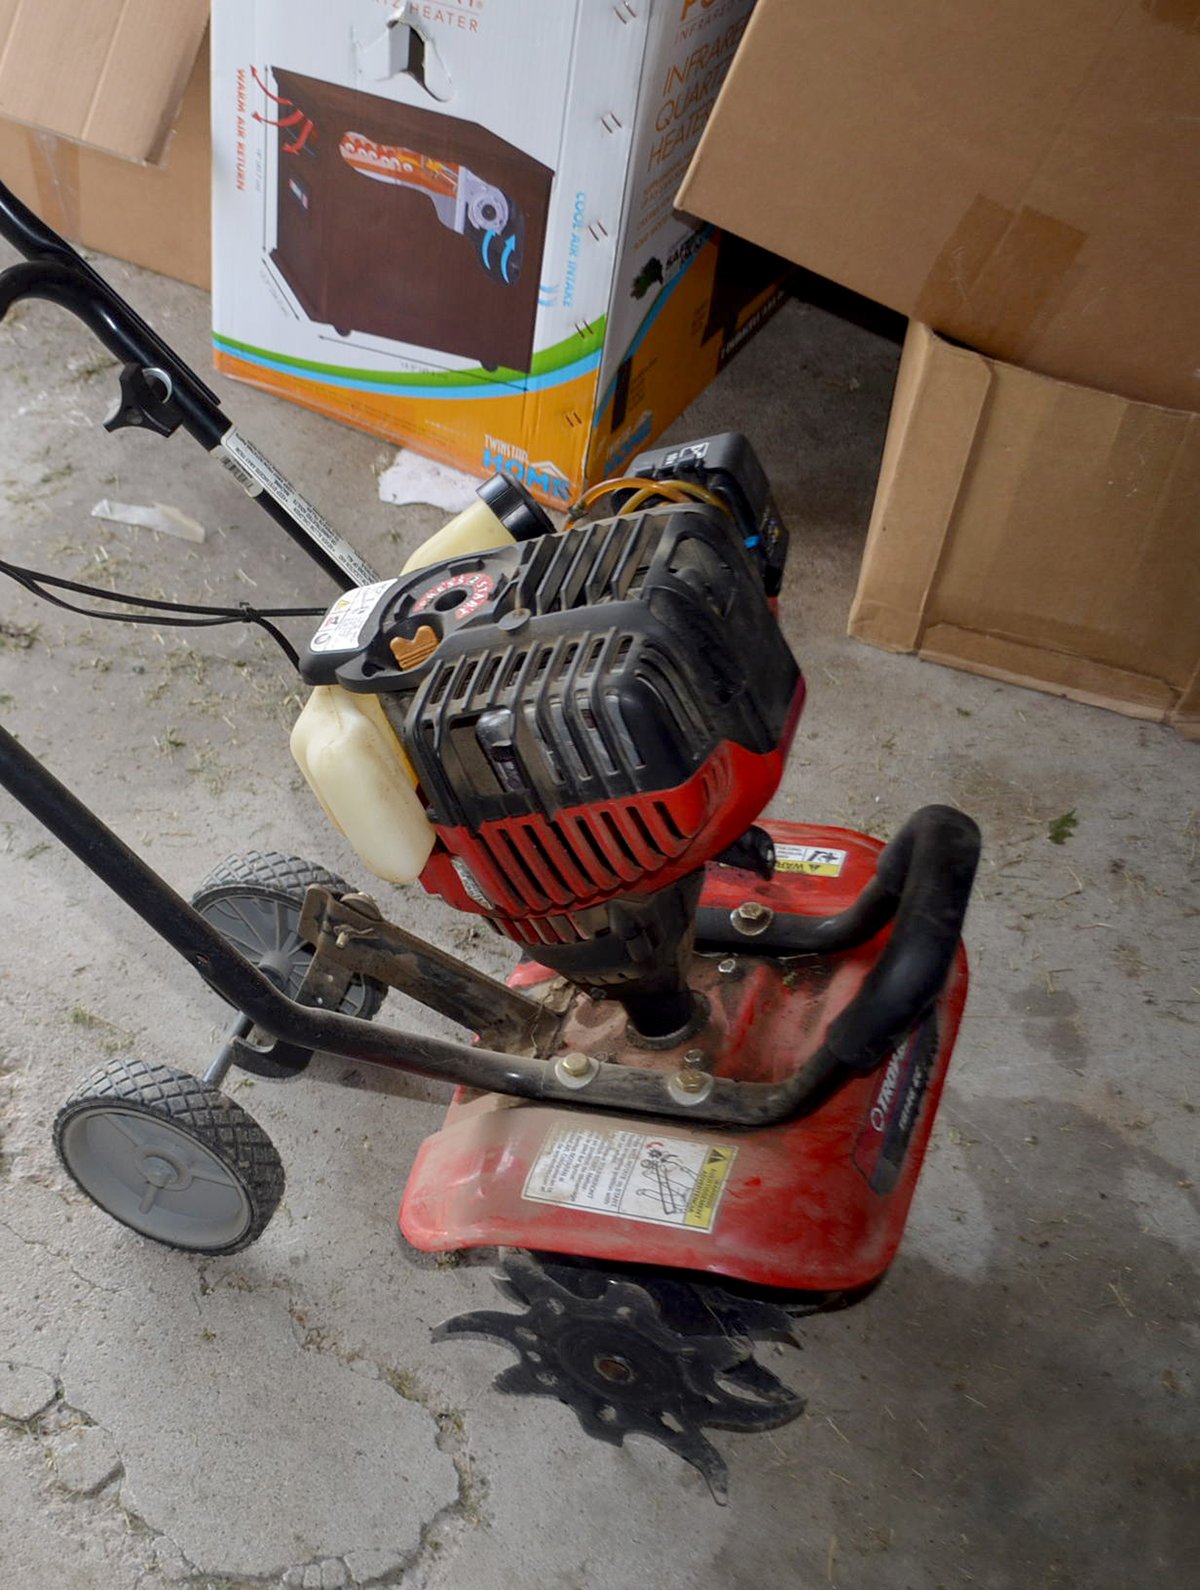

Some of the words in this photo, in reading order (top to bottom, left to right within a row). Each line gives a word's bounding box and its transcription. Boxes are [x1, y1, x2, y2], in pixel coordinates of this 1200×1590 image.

[409, 2, 479, 32] HEATER
[237, 69, 247, 112] WARM
[237, 116, 246, 138] AIR
[236, 142, 246, 191] RETURN
[571, 191, 588, 230] COOL
[569, 232, 583, 257] AIR
[562, 260, 580, 308] INTAKE
[483, 449, 570, 501] HOME
